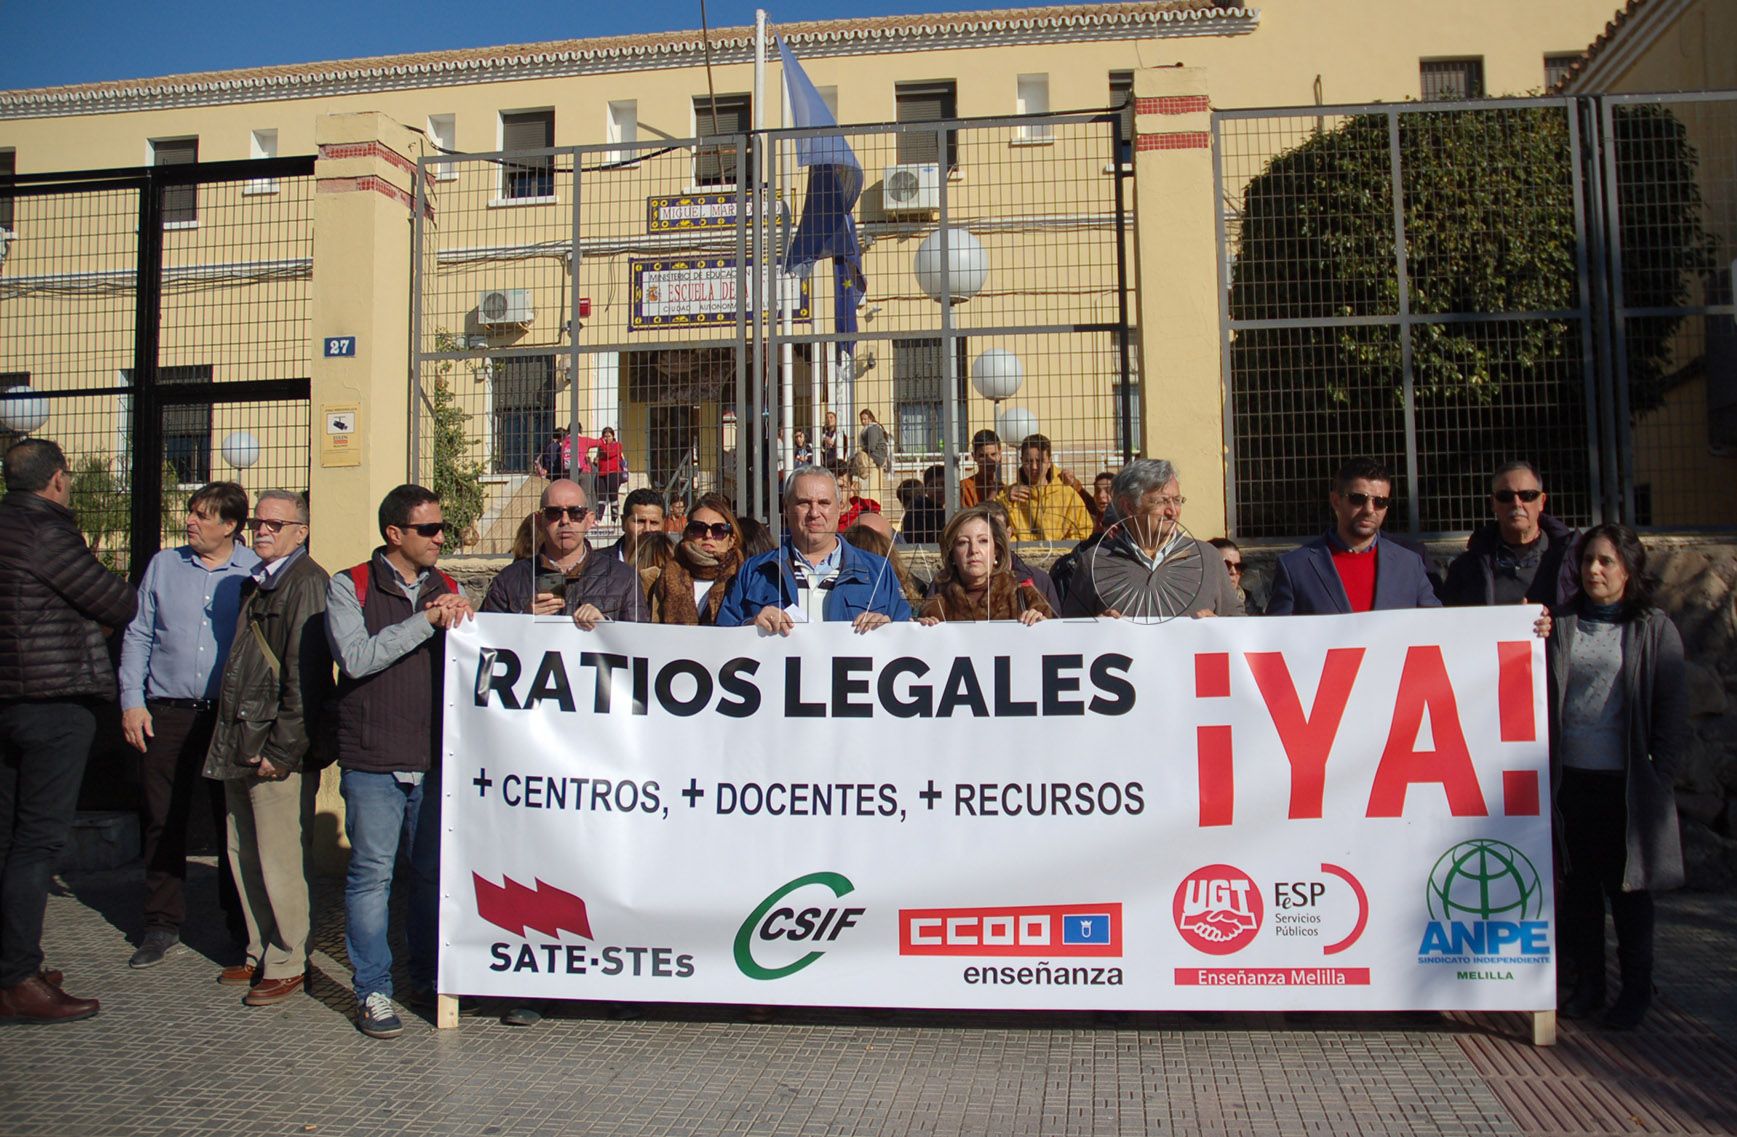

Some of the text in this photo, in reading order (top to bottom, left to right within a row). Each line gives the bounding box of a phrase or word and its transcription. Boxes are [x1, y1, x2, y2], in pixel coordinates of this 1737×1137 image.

[649, 271, 691, 282] MINISTERIO
[693, 271, 704, 280] DE
[668, 282, 715, 303] ESCUELA
[721, 281, 737, 301] DE
[329, 340, 350, 355] 27
[474, 647, 1137, 718] RATIOS LEGALES
[1194, 641, 1540, 827] ¡YA!
[503, 774, 669, 819] CENTROS,
[716, 782, 907, 822] DOCENTES,
[955, 782, 1146, 816] RECURSOS
[1184, 879, 1251, 914] UGT
[759, 907, 867, 942] CSIF
[1275, 913, 1321, 924] Servicios
[910, 915, 1051, 946] CCOO
[1275, 925, 1319, 937] Públicos
[1418, 921, 1551, 955] ANPE
[1418, 956, 1551, 965] SINDICATO INDEPENDIENTE
[963, 961, 1124, 985] enseñanza
[1199, 970, 1346, 985] Enseñanza Melilla
[1457, 971, 1514, 980] MELILLA
